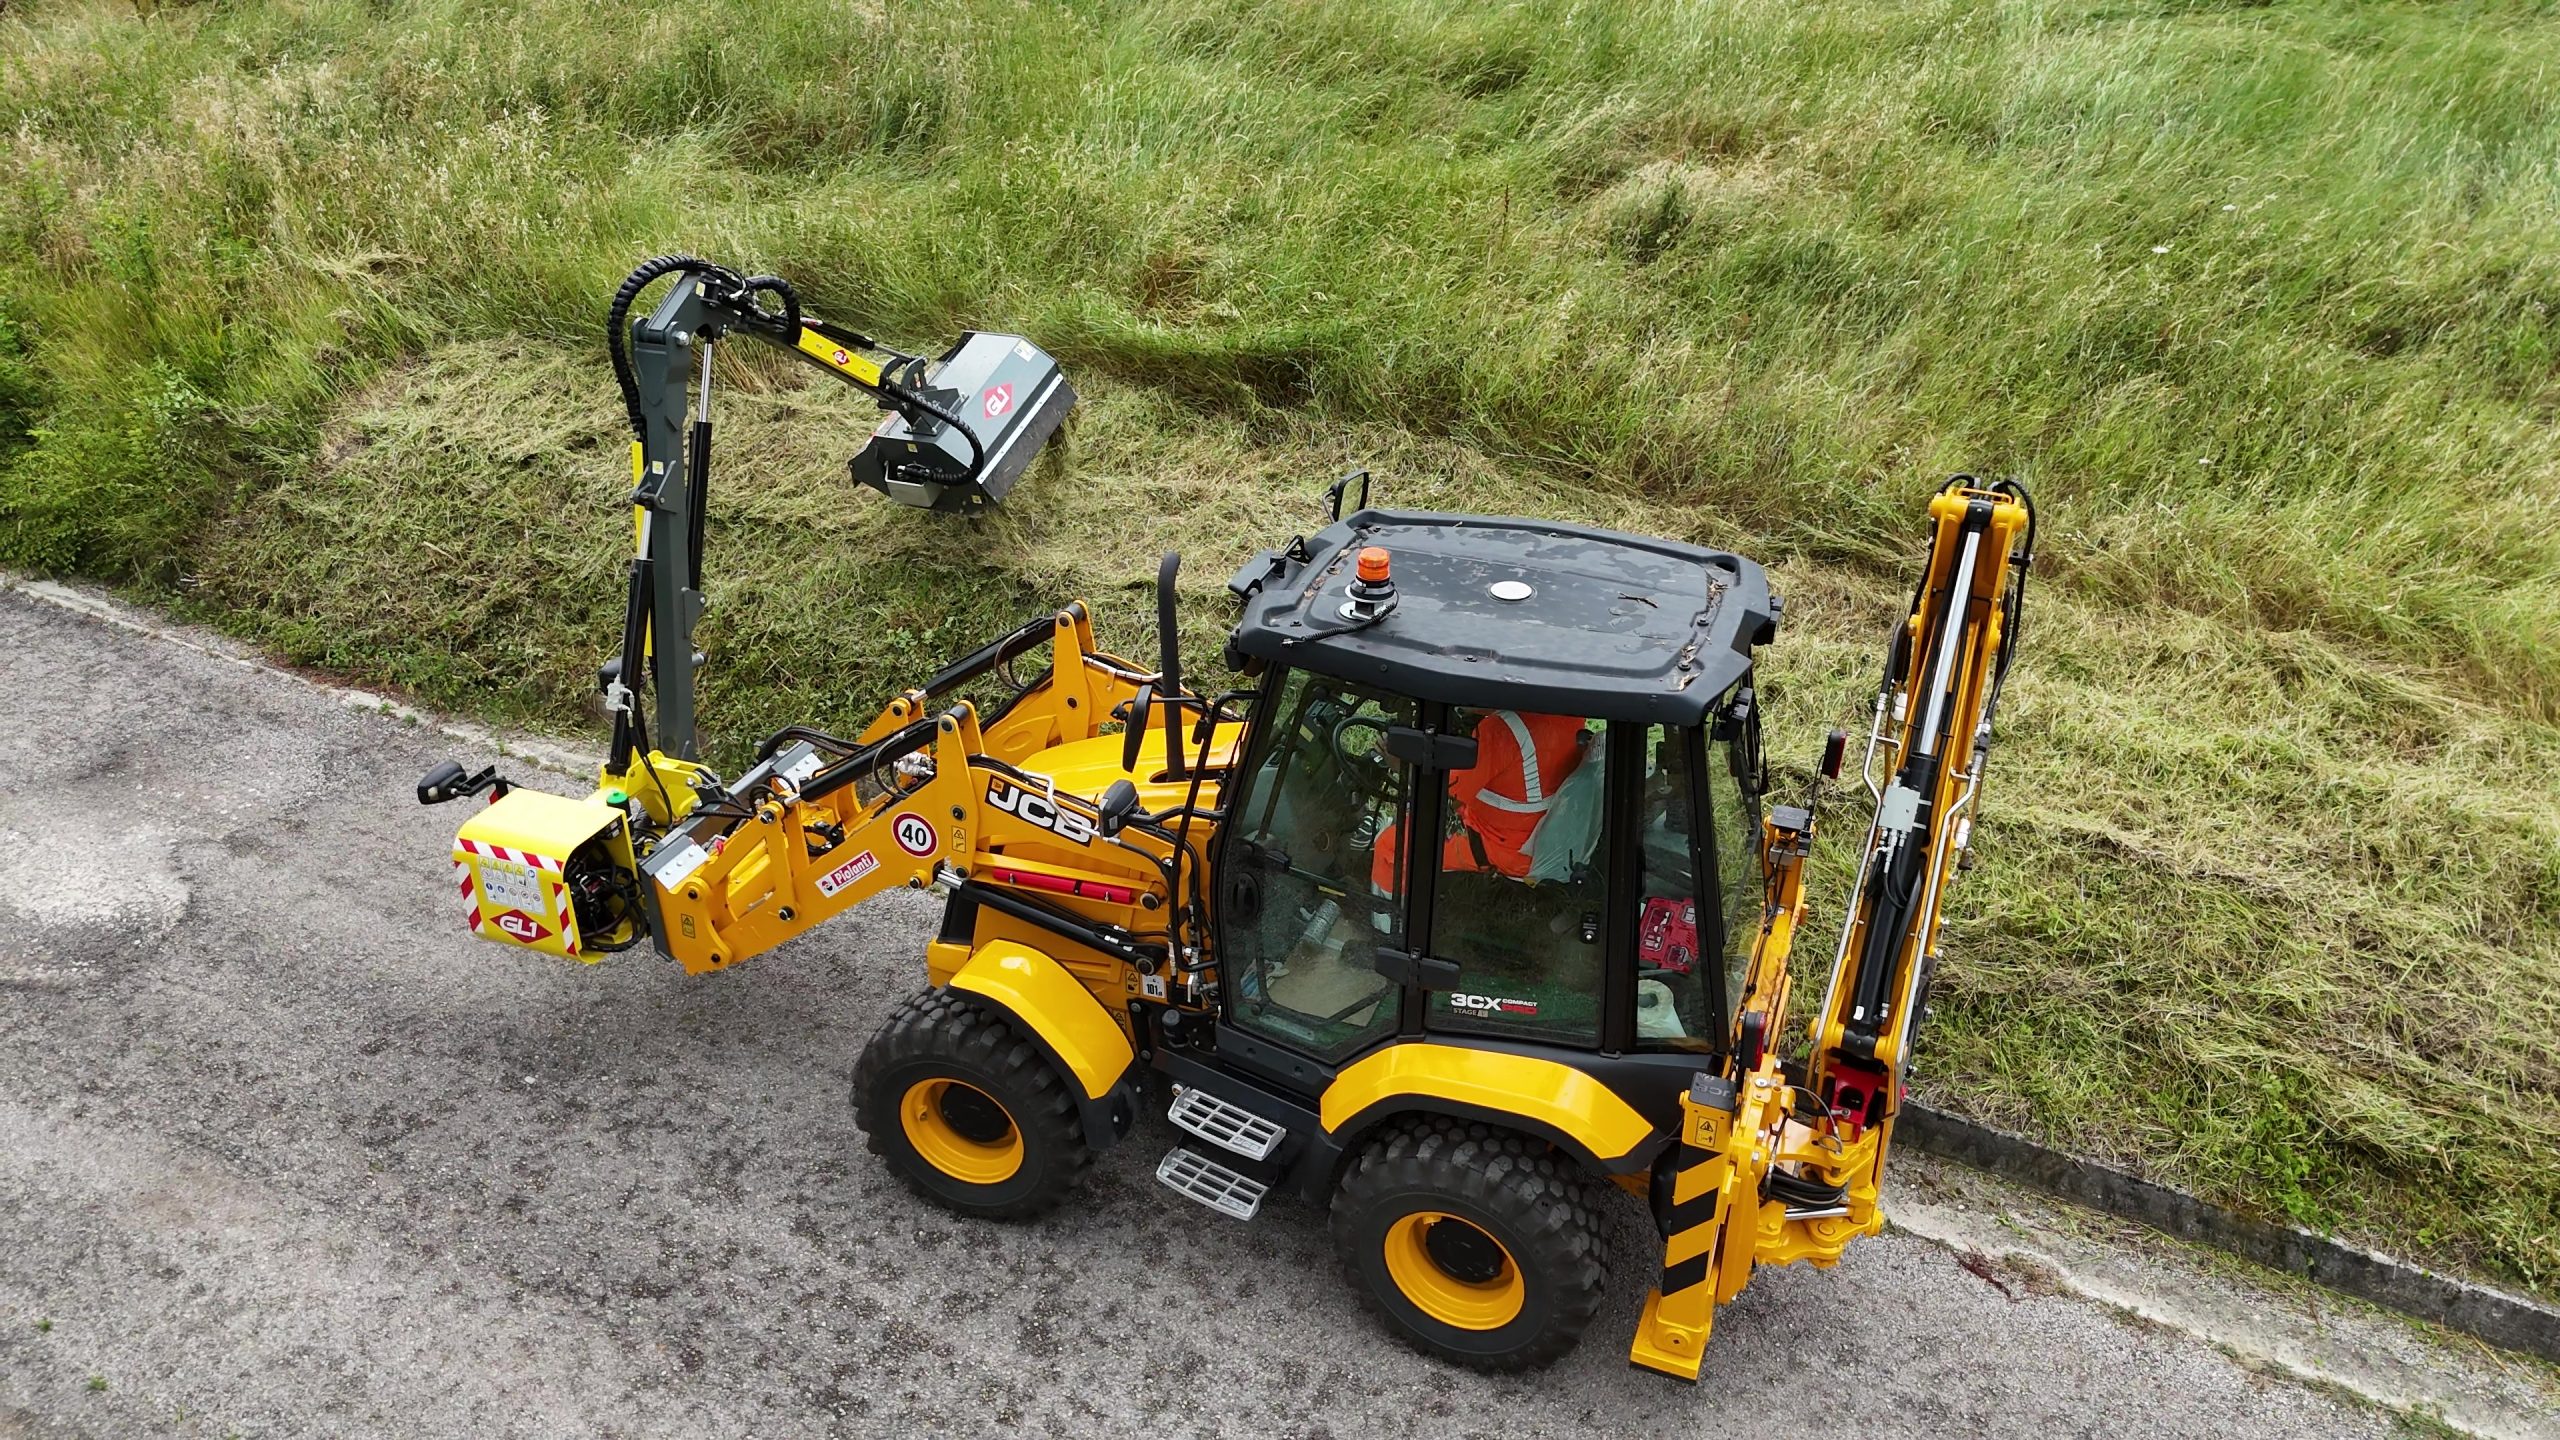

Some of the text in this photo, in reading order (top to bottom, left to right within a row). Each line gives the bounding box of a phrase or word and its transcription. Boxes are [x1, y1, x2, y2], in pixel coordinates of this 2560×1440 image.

[988, 786, 1092, 843] JCB
[902, 823, 927, 847] 40
[834, 854, 873, 884] Piolanti
[1146, 983, 1158, 996] 101
[1450, 993, 1538, 1011] 3CX COMPACT
[1453, 1007, 1477, 1017] STAGE
